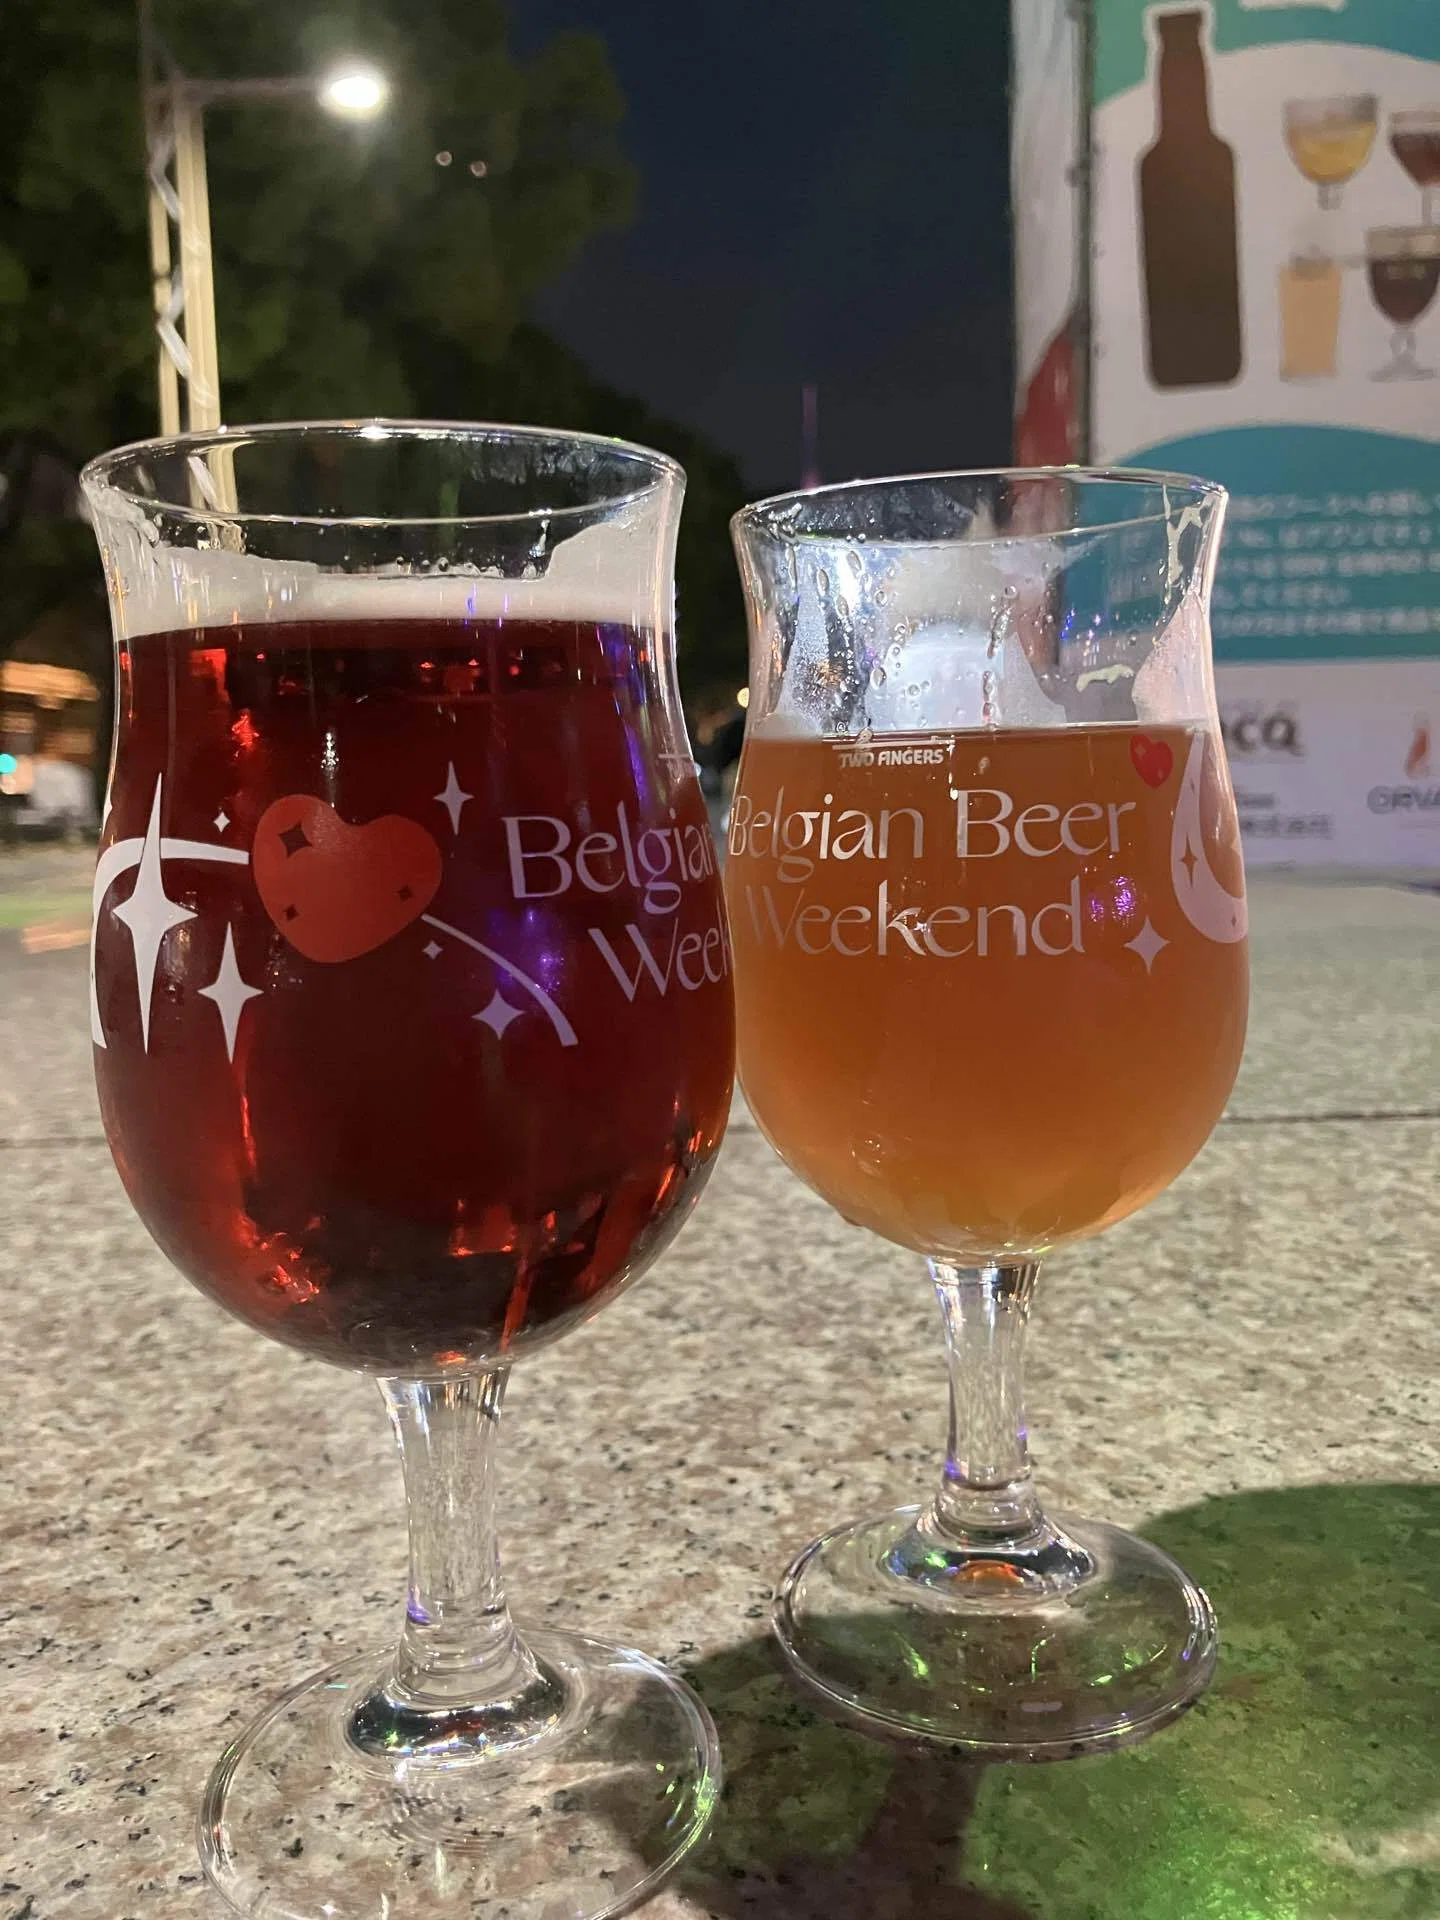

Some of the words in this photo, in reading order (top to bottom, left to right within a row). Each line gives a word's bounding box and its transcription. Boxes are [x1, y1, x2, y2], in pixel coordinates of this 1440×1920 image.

[839, 752, 875, 768] TWO
[877, 748, 944, 767] FINGERS
[1220, 712, 1305, 757] CQ
[730, 786, 925, 884] Belgian
[956, 788, 1137, 858] Beer
[744, 874, 1086, 957] Weekend
